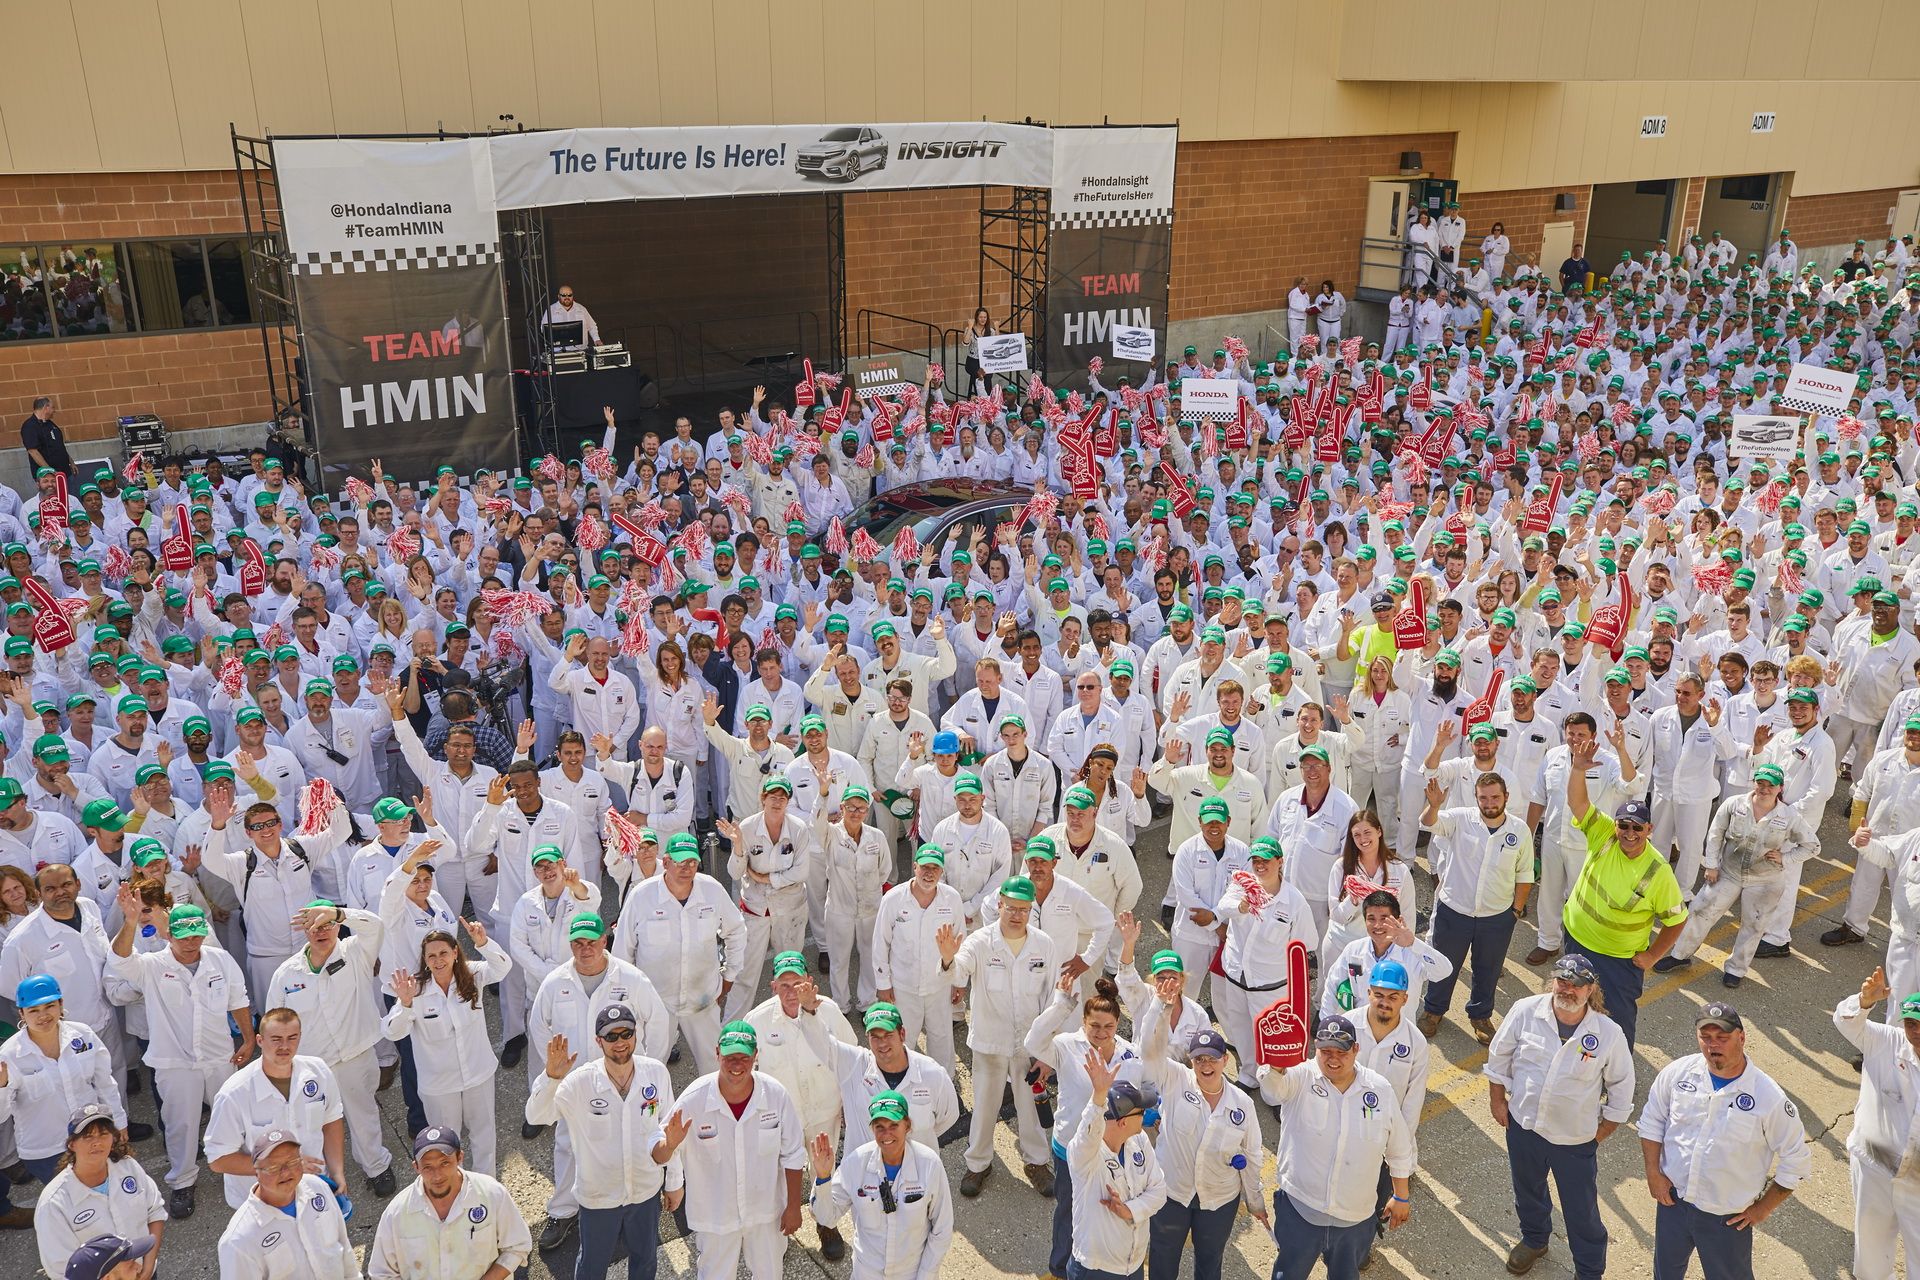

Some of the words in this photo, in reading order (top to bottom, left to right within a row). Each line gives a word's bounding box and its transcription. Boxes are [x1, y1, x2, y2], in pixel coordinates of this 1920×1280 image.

[1641, 119, 1659, 135] ADM
[1660, 118, 1666, 134] 8
[1752, 115, 1768, 130] ADM
[1769, 115, 1776, 129] 7
[896, 140, 1007, 160] INSIGHT
[549, 148, 596, 175] The
[605, 147, 687, 171] Future
[695, 145, 716, 169] Is
[724, 143, 786, 168] Here!
[1081, 175, 1148, 187] #HondaInsight
[1073, 190, 1153, 202] #TheFutureIsHere
[330, 201, 452, 217] @HondaIndiana
[1750, 202, 1764, 211] ADM
[345, 221, 444, 238] #TeamHMIN
[1081, 272, 1140, 297] TEAM
[1063, 306, 1151, 346] HMIN
[362, 328, 461, 363] TEAM
[868, 361, 888, 370] TEAM
[860, 367, 898, 384] HMIN
[1797, 378, 1842, 393] HONDA
[339, 373, 487, 429] HMIN
[1189, 391, 1228, 399] HONDA
[1736, 444, 1791, 453] #TheFutureIsHere
[44, 629, 69, 642] HONDA
[1591, 626, 1616, 638] HONDA
[1264, 1043, 1302, 1051] HONDA
